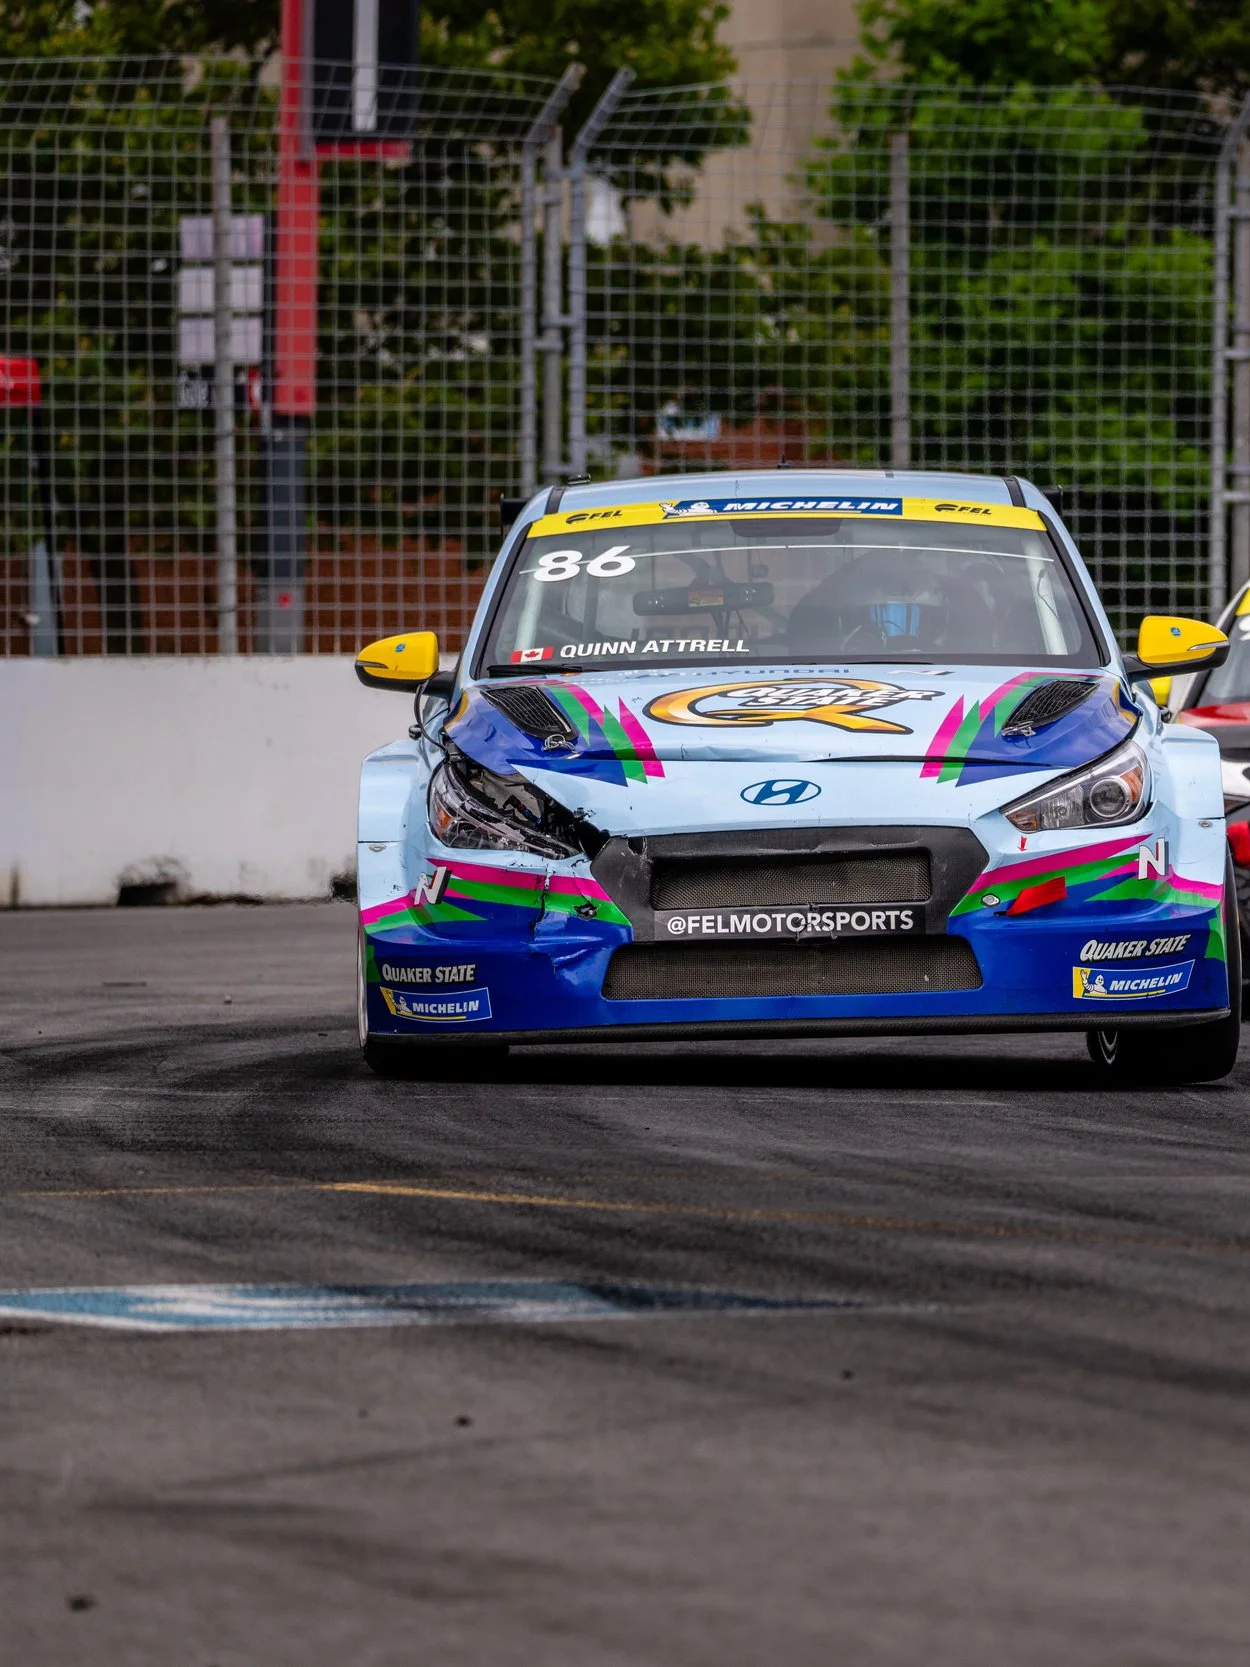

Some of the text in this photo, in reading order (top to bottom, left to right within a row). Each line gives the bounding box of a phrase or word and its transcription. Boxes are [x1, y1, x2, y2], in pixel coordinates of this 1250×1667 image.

[722, 500, 899, 512] MICHELIN
[533, 545, 636, 582] 86
[560, 639, 750, 659] QUINN ATTRELL
[725, 687, 936, 699] QUAKER
[746, 695, 898, 706] STATE
[667, 910, 914, 935] @FELMOTORSPORTS
[1079, 934, 1191, 962] QUAKER STATE
[382, 963, 476, 983] QUAKER STATE
[1109, 972, 1183, 991] MICHELIN
[412, 1000, 480, 1014] MICHELIN
